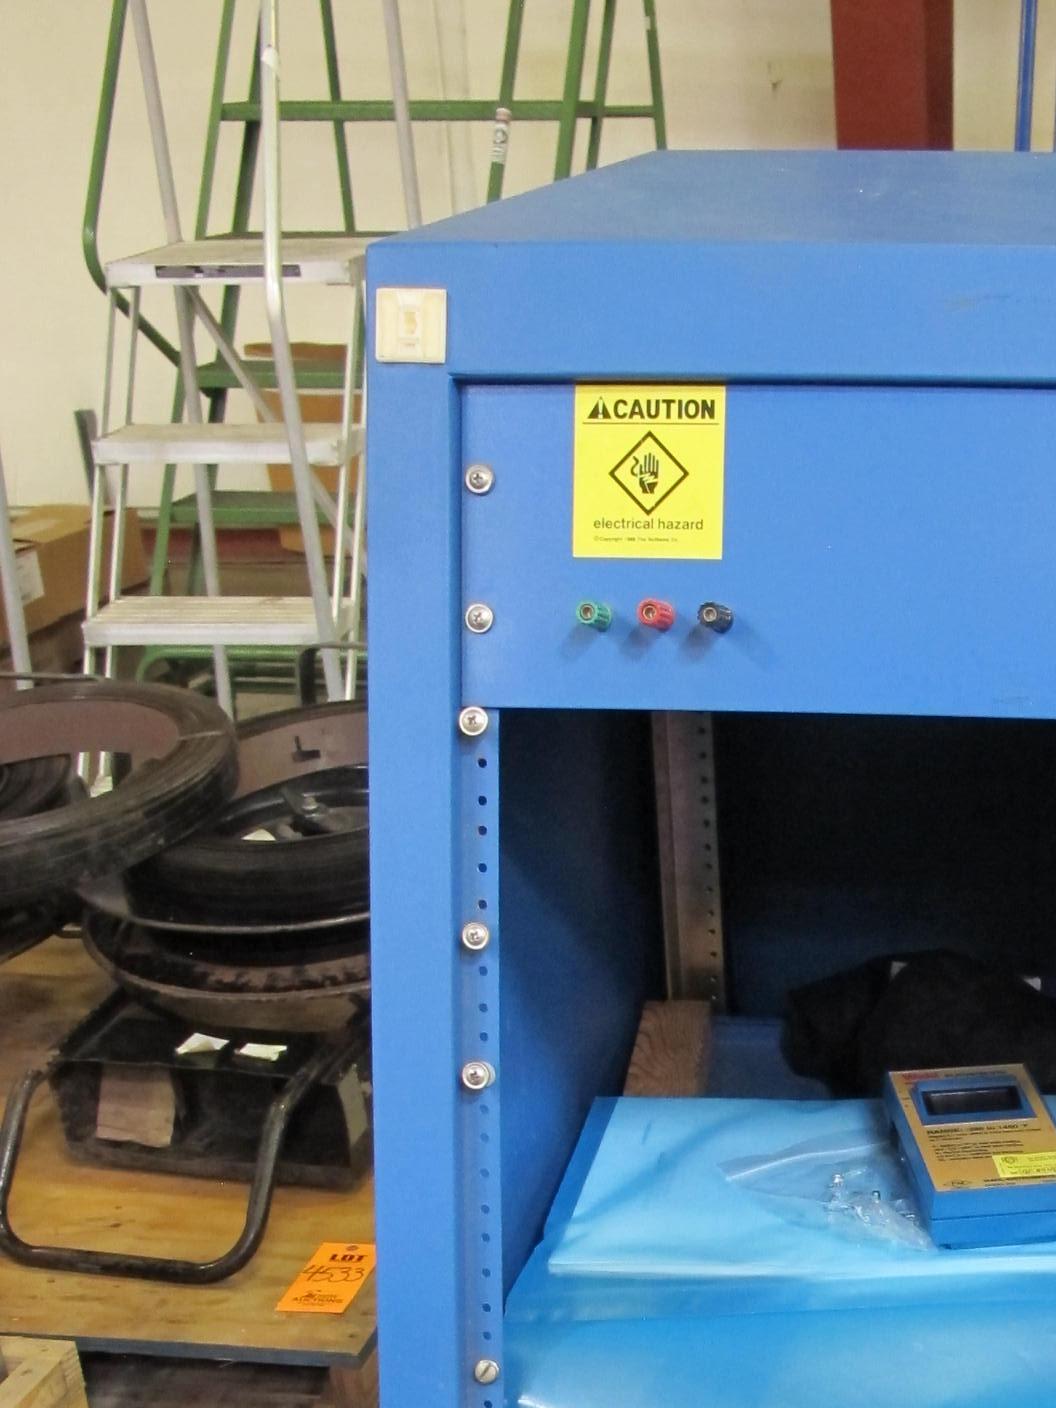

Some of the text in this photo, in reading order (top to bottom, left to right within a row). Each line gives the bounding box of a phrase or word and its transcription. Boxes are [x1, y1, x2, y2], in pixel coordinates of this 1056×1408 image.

[613, 399, 716, 420] CAUTION
[593, 518, 704, 531] electrical hazard
[329, 1253, 368, 1262] LOT
[297, 1264, 365, 1283] 4533
